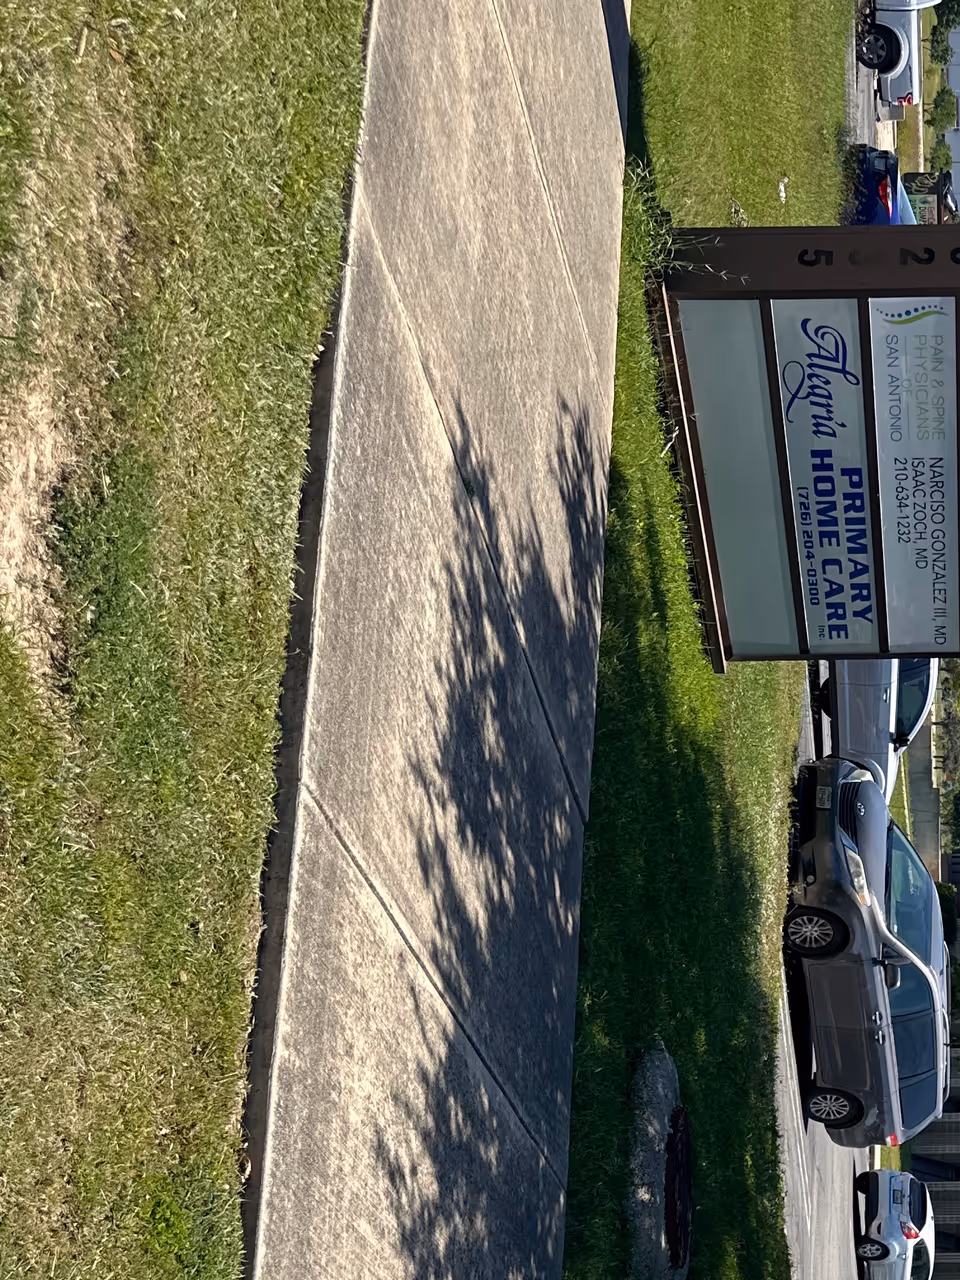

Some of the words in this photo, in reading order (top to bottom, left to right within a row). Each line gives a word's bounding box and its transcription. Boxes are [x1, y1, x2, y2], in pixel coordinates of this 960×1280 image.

[885, 334, 900, 368] SAN
[930, 335, 945, 372] PAIN
[888, 374, 903, 442] ANTONIO
[913, 335, 930, 440] PHYSICIANS
[931, 378, 945, 388] &
[931, 396, 946, 440] SPINE
[810, 449, 841, 548] HOME
[894, 457, 911, 544] 210-634-1232
[911, 457, 927, 498] ISAAC
[929, 457, 946, 524] NARCISO
[797, 486, 813, 526] (726)
[912, 502, 928, 544] ZOCH,
[802, 530, 820, 606] 204-0300
[840, 467, 873, 625] PRIMARY
[914, 548, 928, 570] MD
[931, 529, 947, 604] GONZALEZ
[821, 558, 849, 641] CARE
[933, 625, 947, 646] MD
